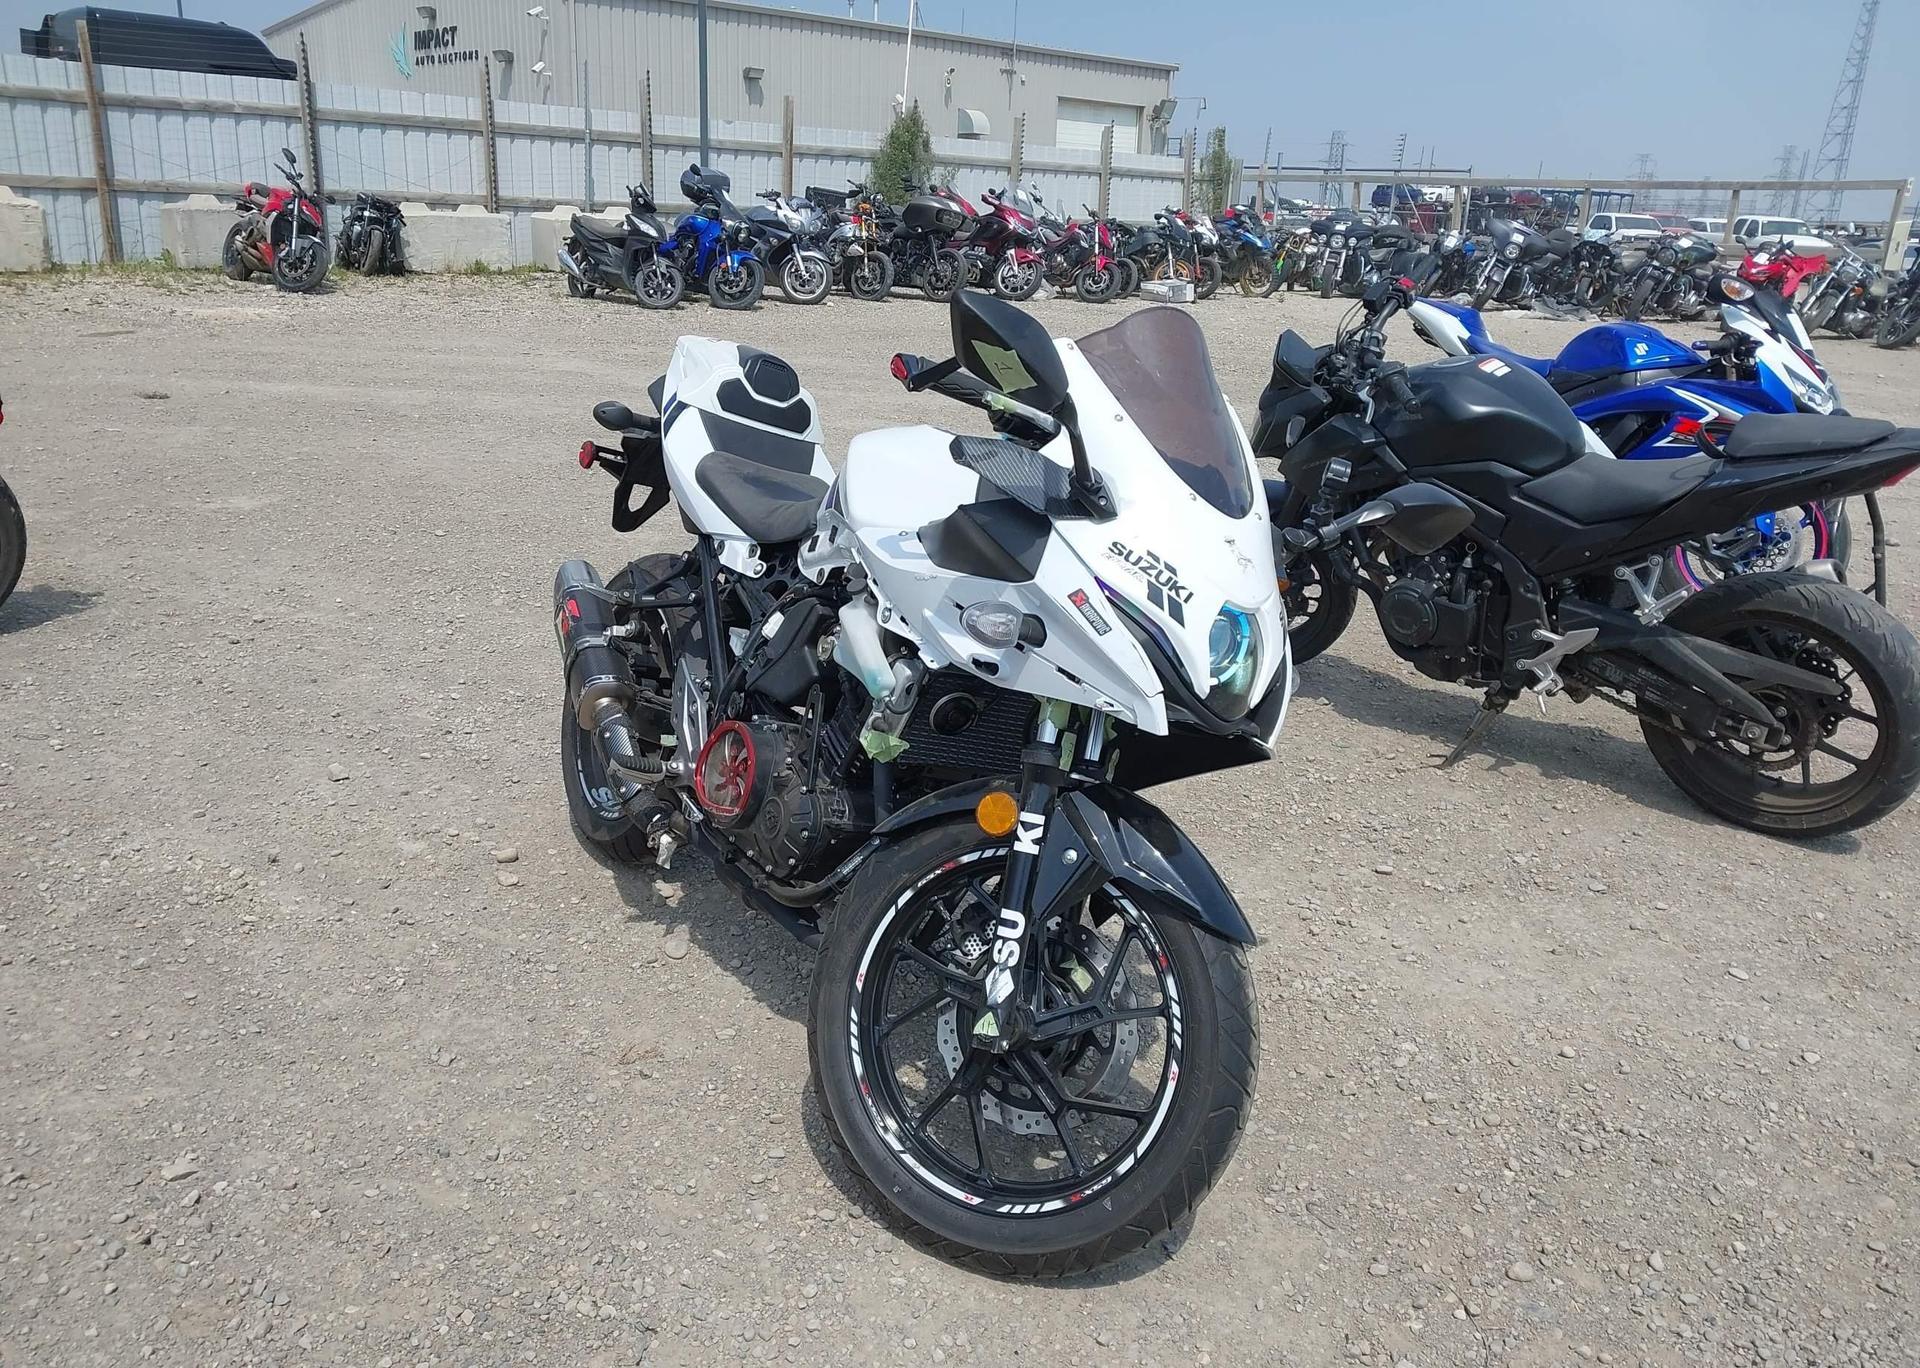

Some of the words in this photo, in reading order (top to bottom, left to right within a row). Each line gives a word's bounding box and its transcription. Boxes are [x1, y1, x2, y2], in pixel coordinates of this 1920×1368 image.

[414, 25, 458, 50] IMPACT
[415, 54, 435, 66] AUTO
[437, 49, 479, 64] AUCTIONS
[1108, 541, 1194, 604] SUZUKI
